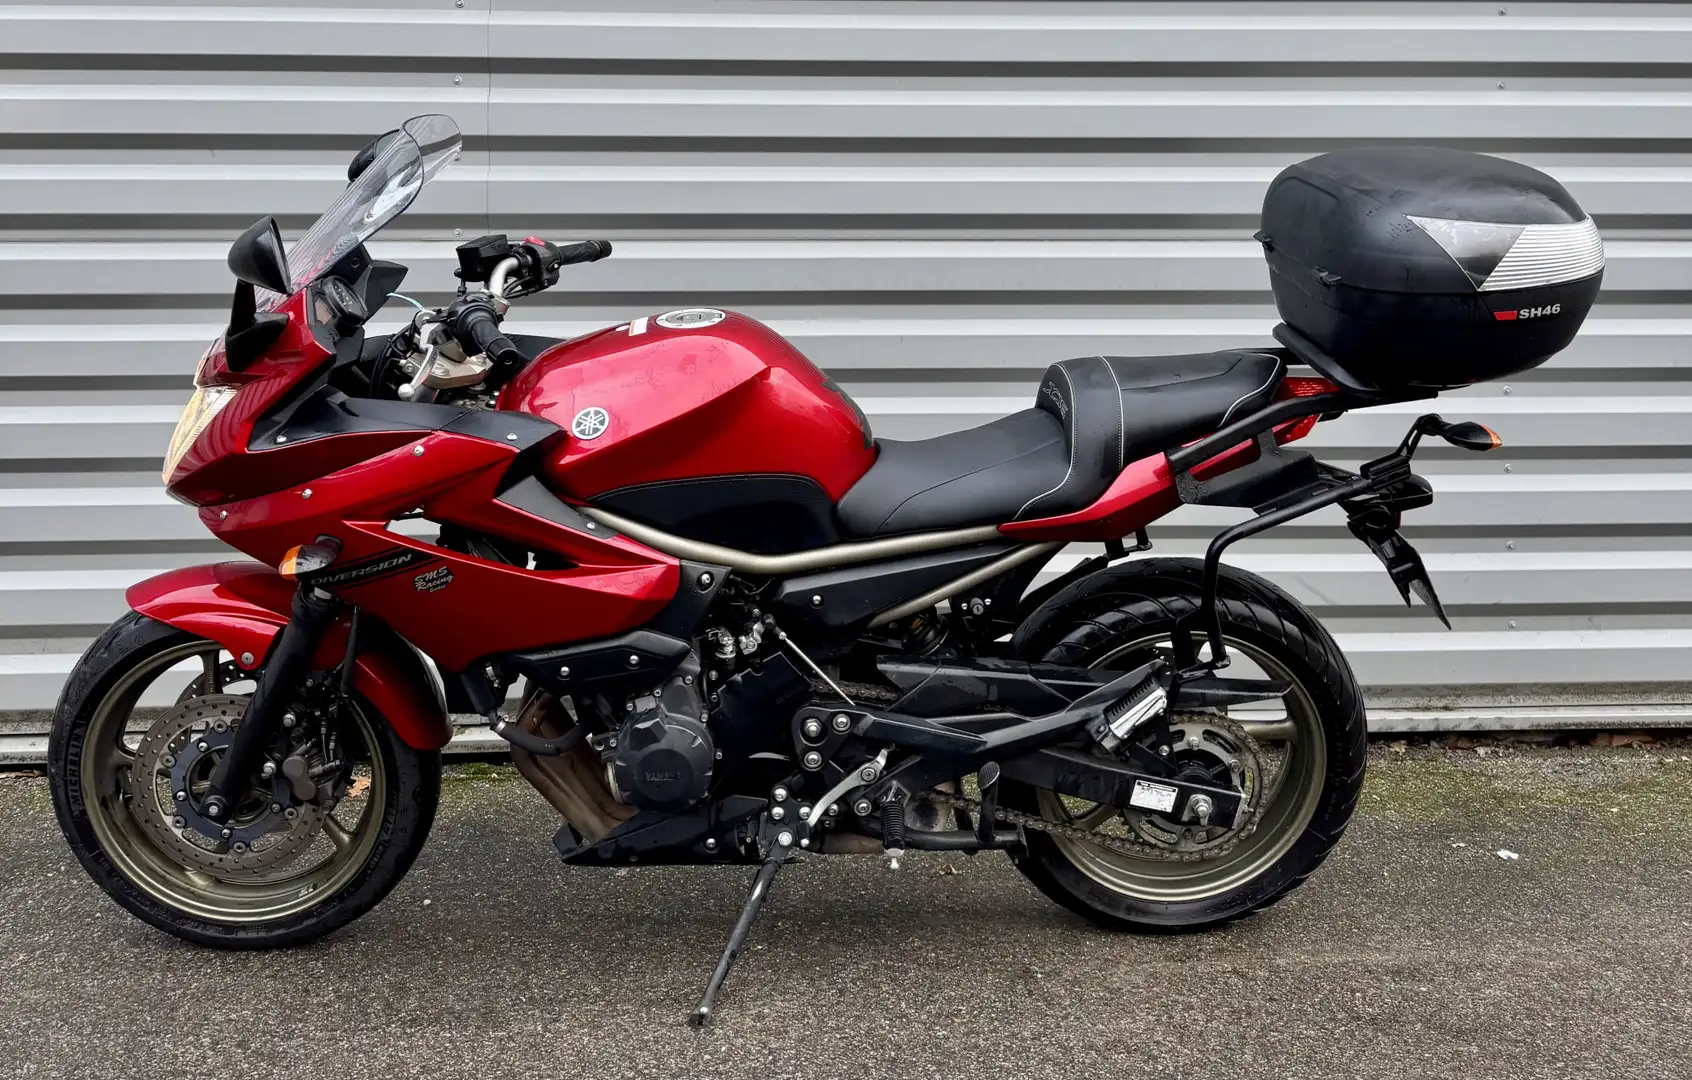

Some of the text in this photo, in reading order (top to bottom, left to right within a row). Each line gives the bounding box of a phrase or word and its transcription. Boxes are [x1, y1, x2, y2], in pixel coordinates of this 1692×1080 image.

[1518, 303, 1561, 319] SH46
[310, 553, 412, 585] DIVERSION
[414, 566, 448, 584] SMS
[415, 574, 454, 592] Racing
